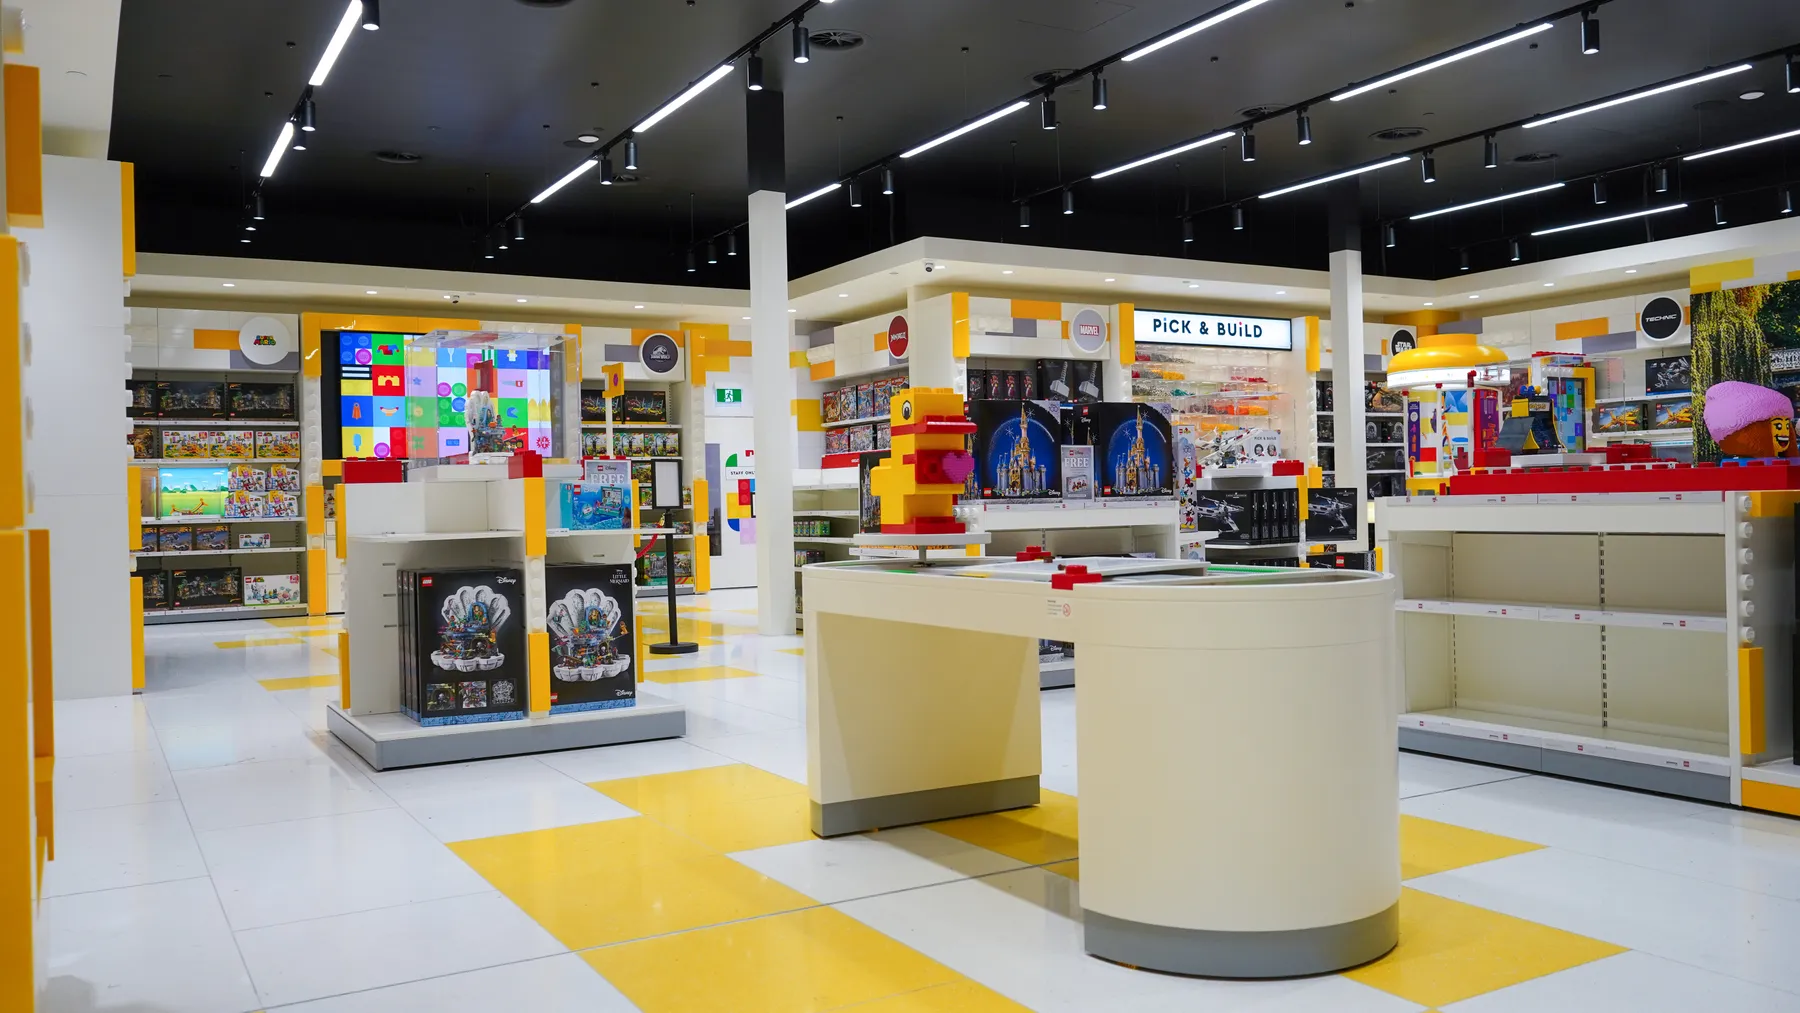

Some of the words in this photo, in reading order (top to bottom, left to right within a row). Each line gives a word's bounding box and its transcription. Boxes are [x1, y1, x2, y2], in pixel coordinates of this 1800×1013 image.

[1645, 314, 1677, 322] TECHNIC
[1080, 325, 1099, 336] MARVEL
[1200, 321, 1209, 335] &
[1064, 457, 1089, 468] FREE
[590, 473, 625, 484] FREE
[1048, 488, 1061, 496] Disney
[1161, 485, 1173, 494] Disney
[496, 576, 517, 584] Disney
[615, 689, 633, 697] Disney
